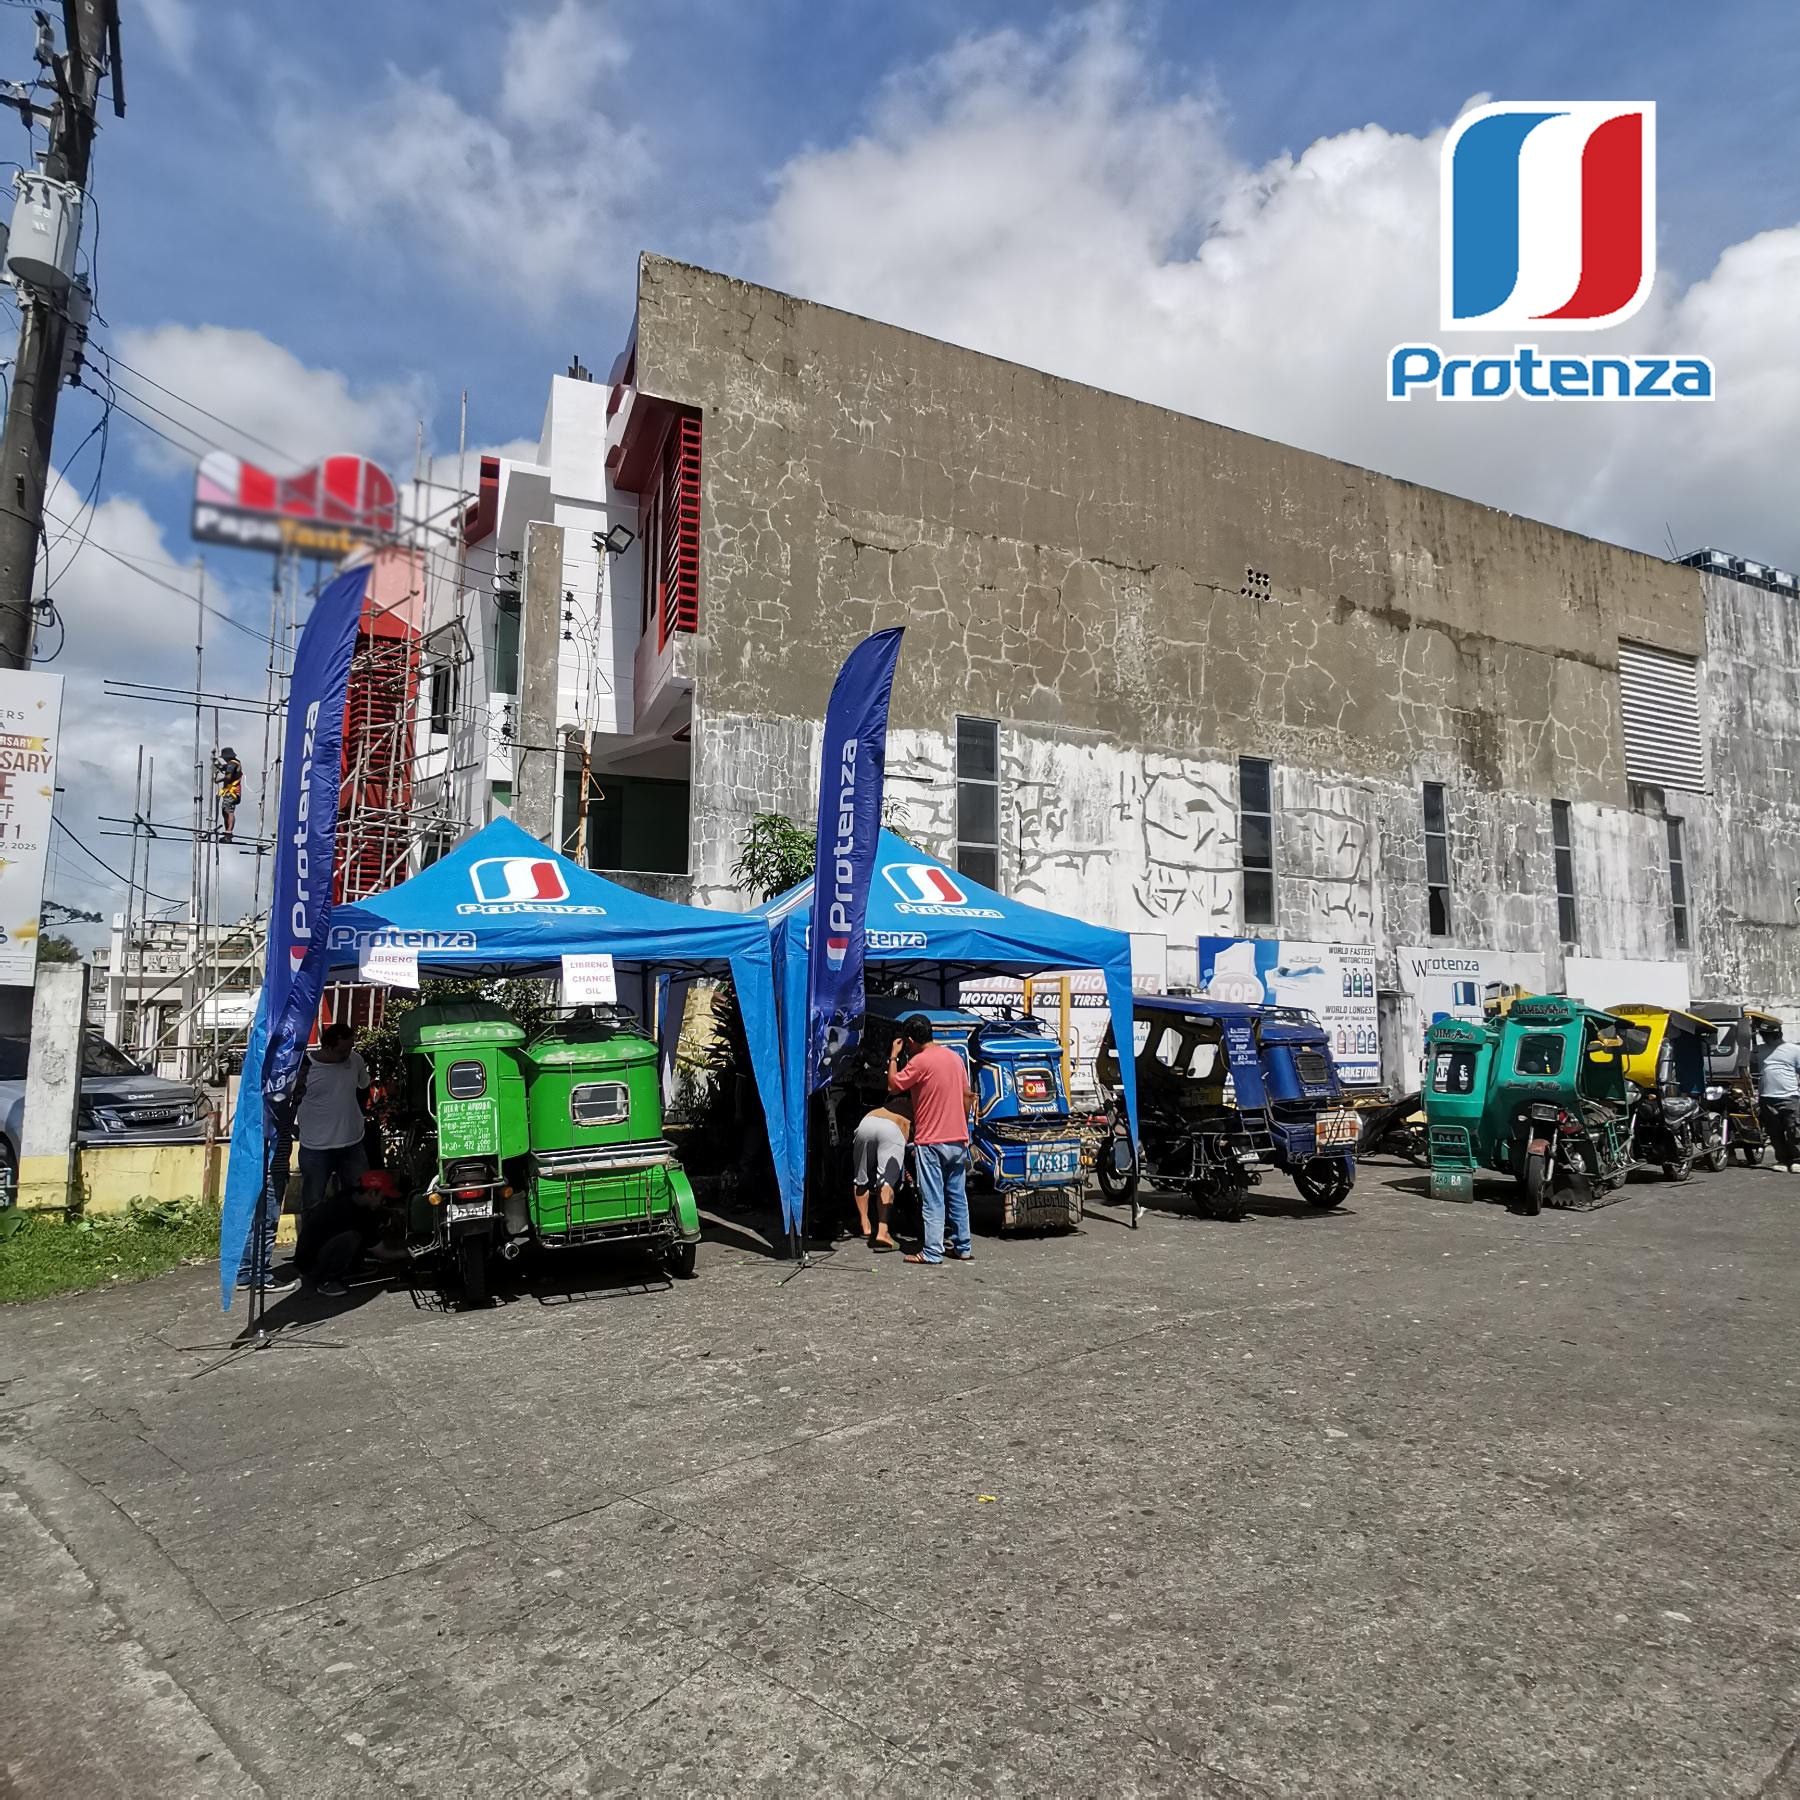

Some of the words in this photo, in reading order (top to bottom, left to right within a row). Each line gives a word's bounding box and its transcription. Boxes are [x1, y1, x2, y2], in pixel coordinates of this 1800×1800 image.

[291, 701, 320, 938] Protenza
[829, 739, 858, 932] Protenza
[457, 902, 606, 914] Protenza
[895, 903, 1005, 918] Protenza
[331, 927, 476, 949] Protenza
[864, 931, 927, 948] tenza
[368, 955, 413, 963] LIBRENG
[570, 961, 609, 969] LIBRENG
[572, 975, 612, 983] CHANGE
[960, 993, 1040, 1006] MOTORCYE
[1074, 995, 1104, 1007] TIRES
[1337, 1066, 1378, 1078] ARKETING
